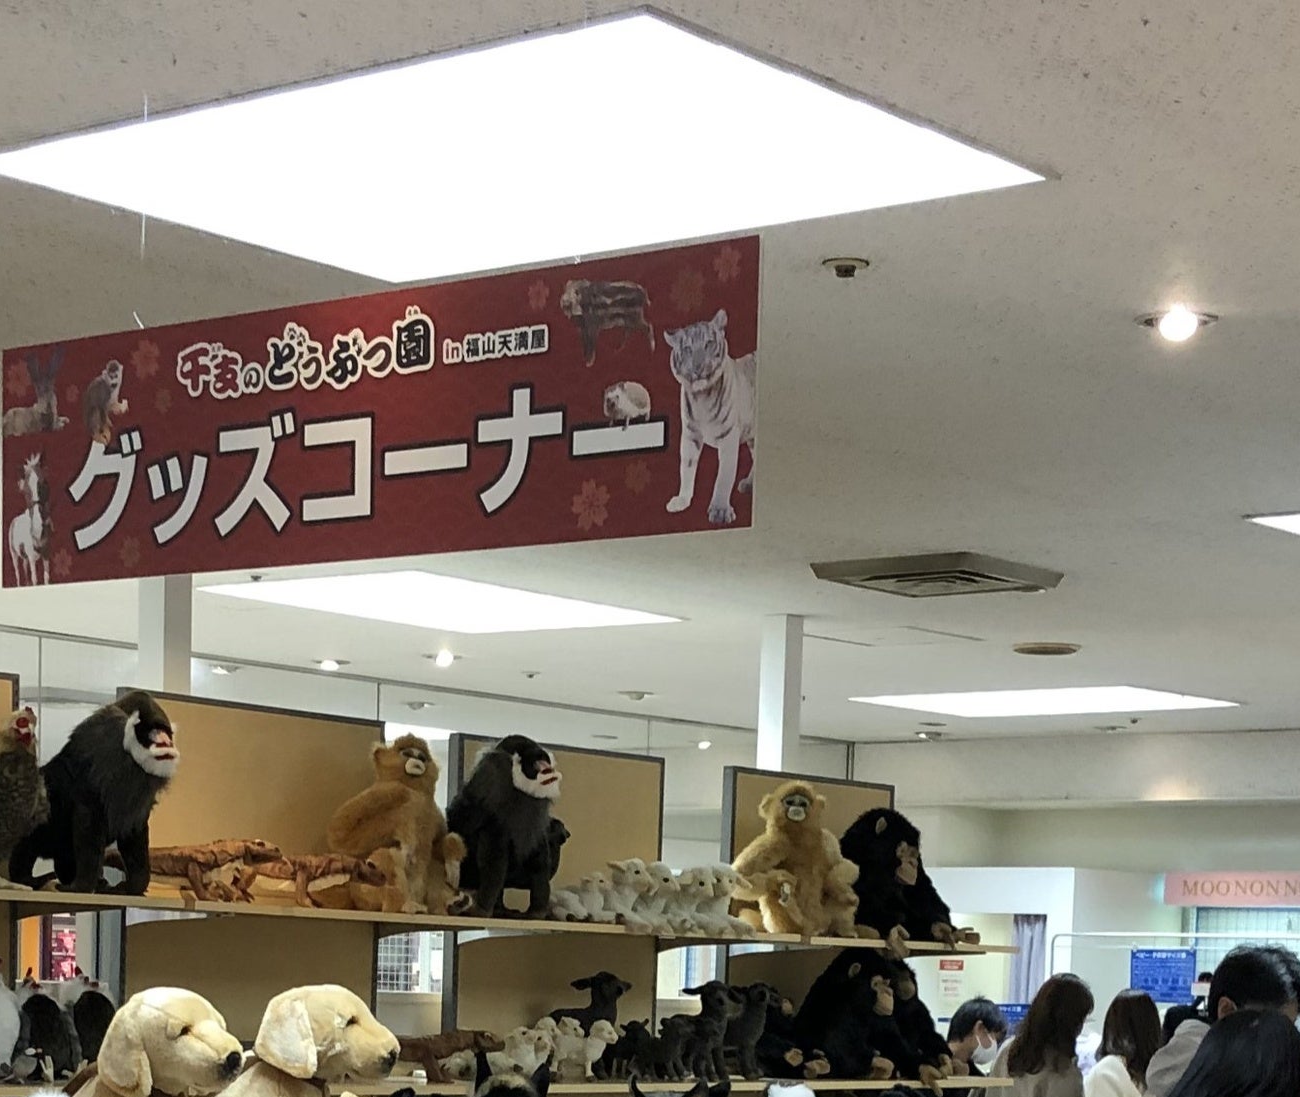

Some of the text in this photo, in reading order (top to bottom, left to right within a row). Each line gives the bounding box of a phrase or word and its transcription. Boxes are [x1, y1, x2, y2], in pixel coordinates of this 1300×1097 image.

[443, 339, 462, 364] in
[464, 326, 548, 362] 福山天満屋
[68, 387, 665, 551] グッズコーナー
